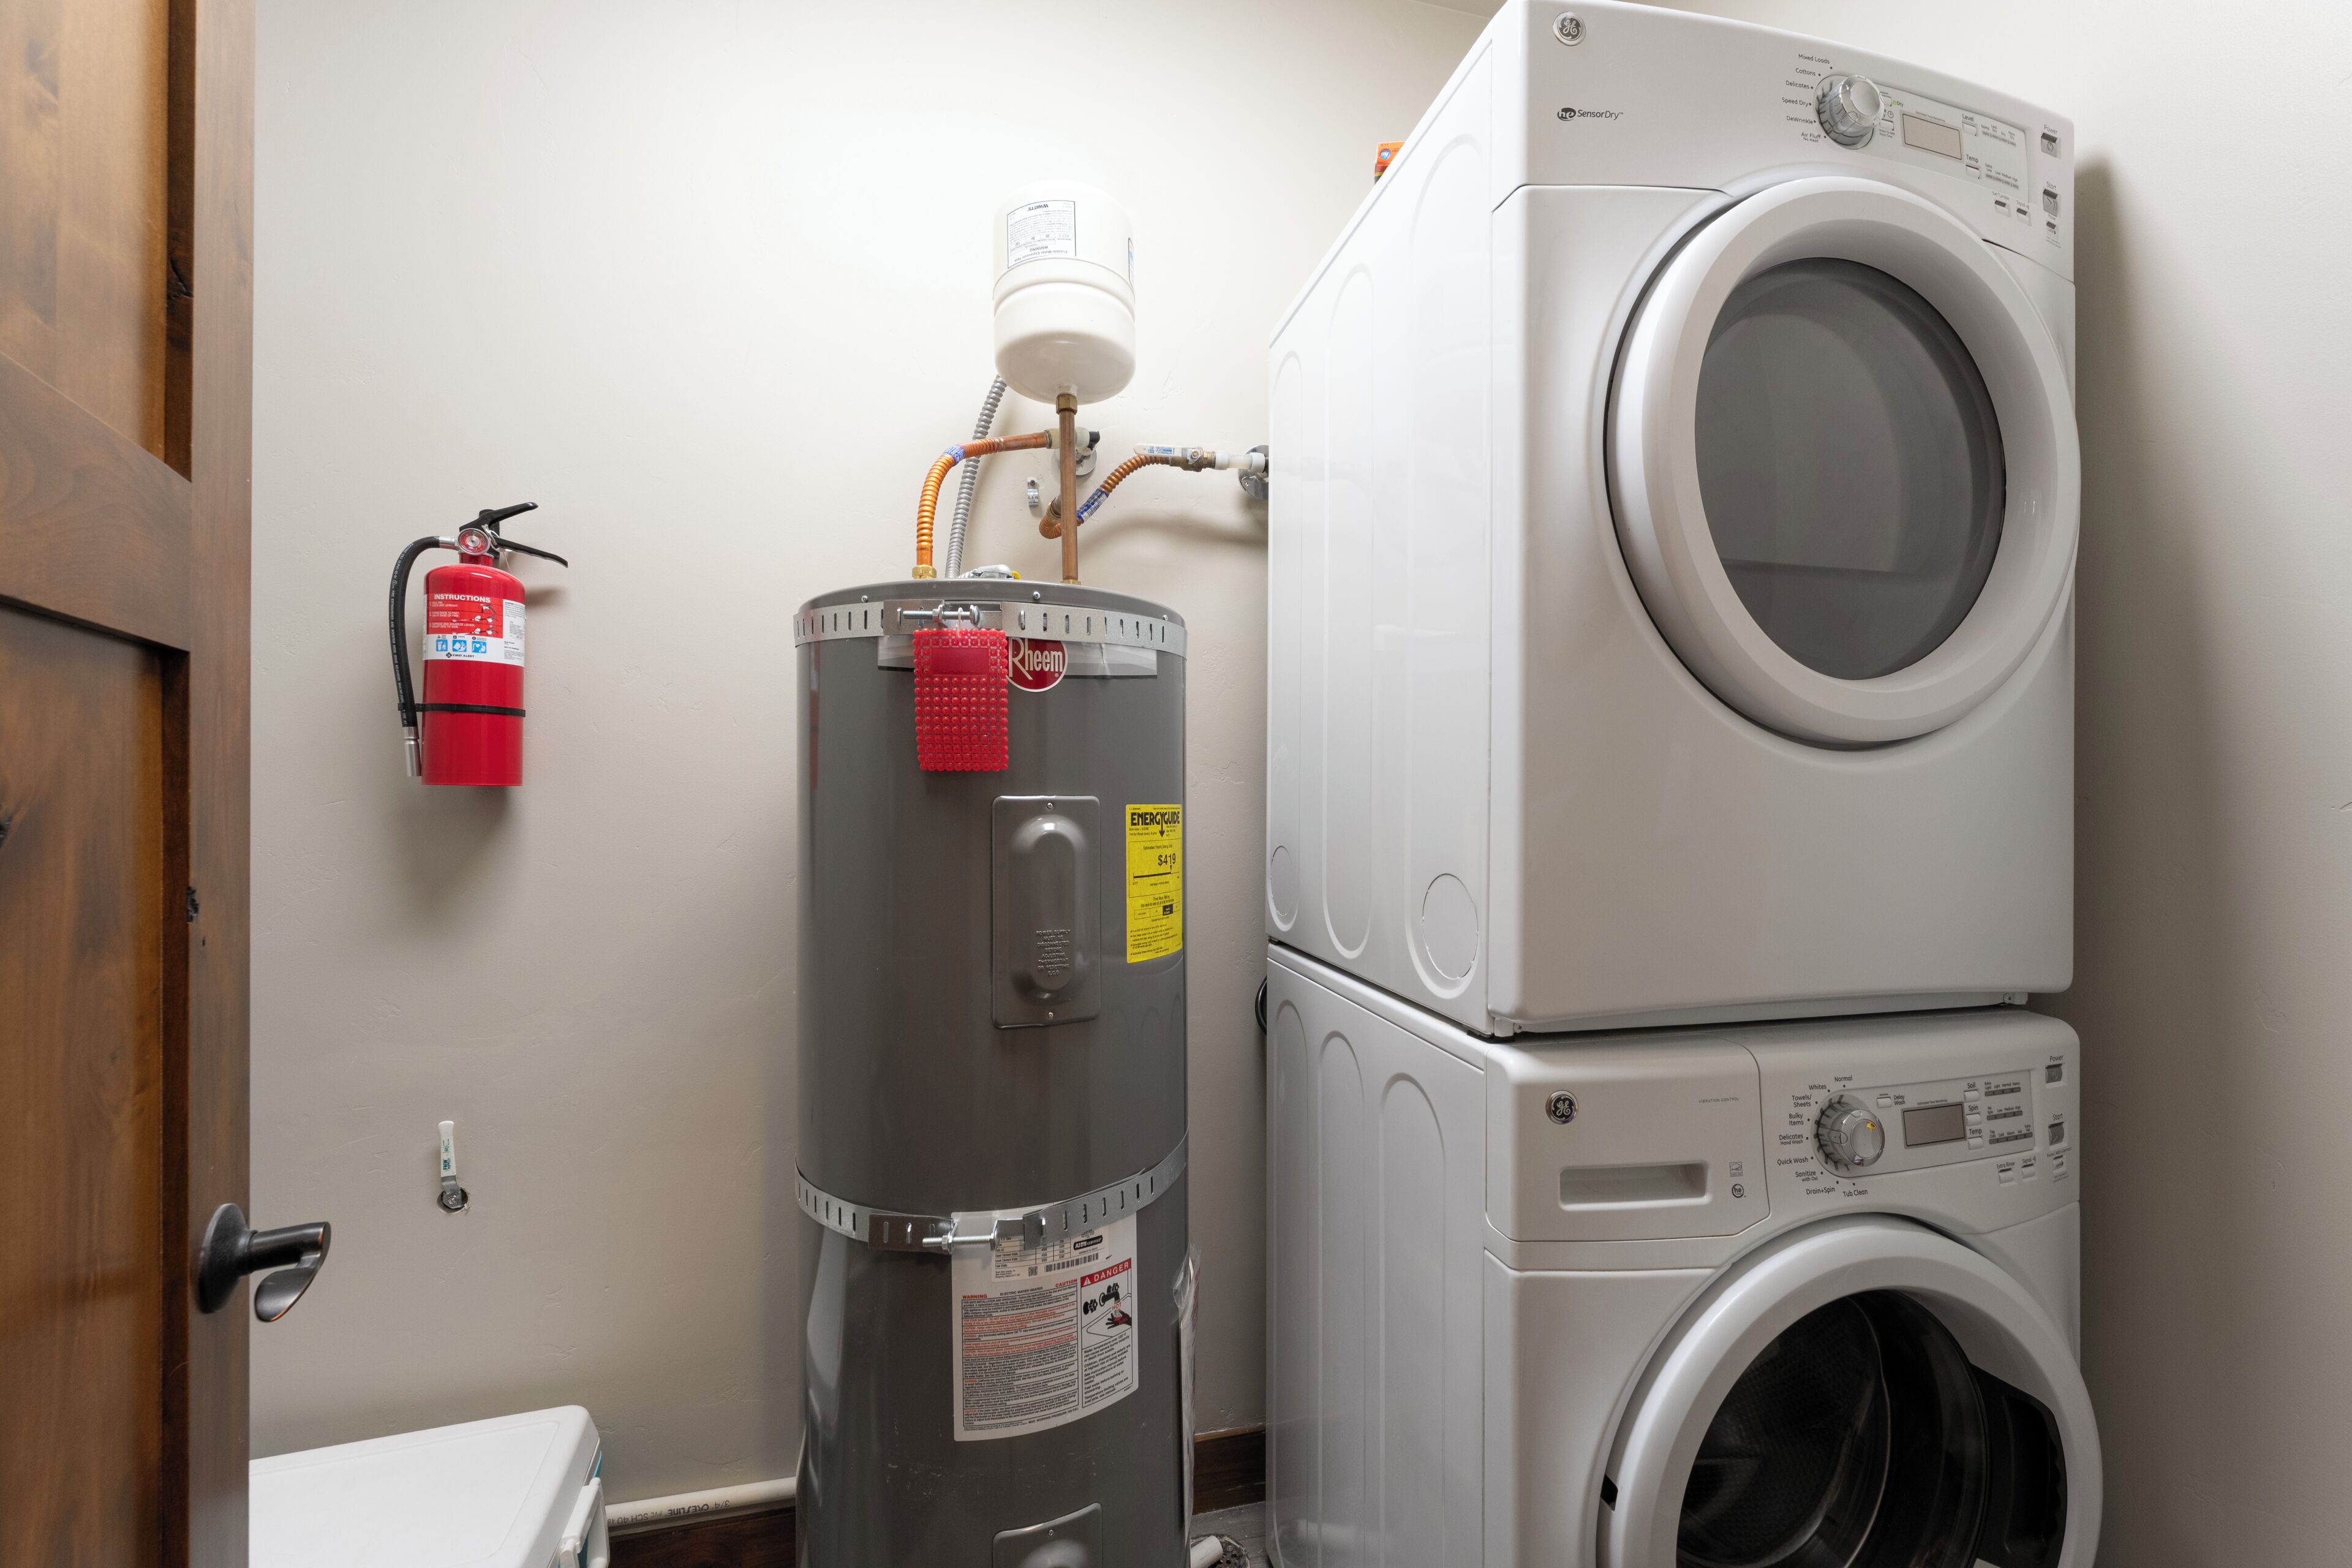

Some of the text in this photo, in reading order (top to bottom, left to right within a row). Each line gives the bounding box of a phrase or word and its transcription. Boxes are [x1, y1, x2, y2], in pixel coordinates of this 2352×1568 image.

[1795, 67, 1816, 77] Cottons
[1785, 80, 1810, 89] Delicates
[1781, 97, 1798, 105] Speed
[1786, 115, 1814, 125] DeWrinkle
[1961, 113, 1975, 122] Level
[2044, 124, 2059, 135] Power
[1966, 154, 1979, 164] Temp
[2046, 181, 2057, 191] Start
[434, 594, 491, 603] INSTRUCTIONS
[1008, 637, 1064, 681] Rheem
[1158, 853, 1176, 867] $419
[2049, 1054, 2064, 1063] Power
[2052, 1113, 2064, 1122] Start
[1806, 1186, 1836, 1196] Drain+Spin
[1094, 1261, 1129, 1282] DANGER
[1055, 1278, 1078, 1287] CAUTION
[1112, 1302, 1122, 1310] HOT
[1051, 1410, 1067, 1419] PRESSURE
[617, 1515, 630, 1525] 40
[631, 1512, 649, 1523] SCH
